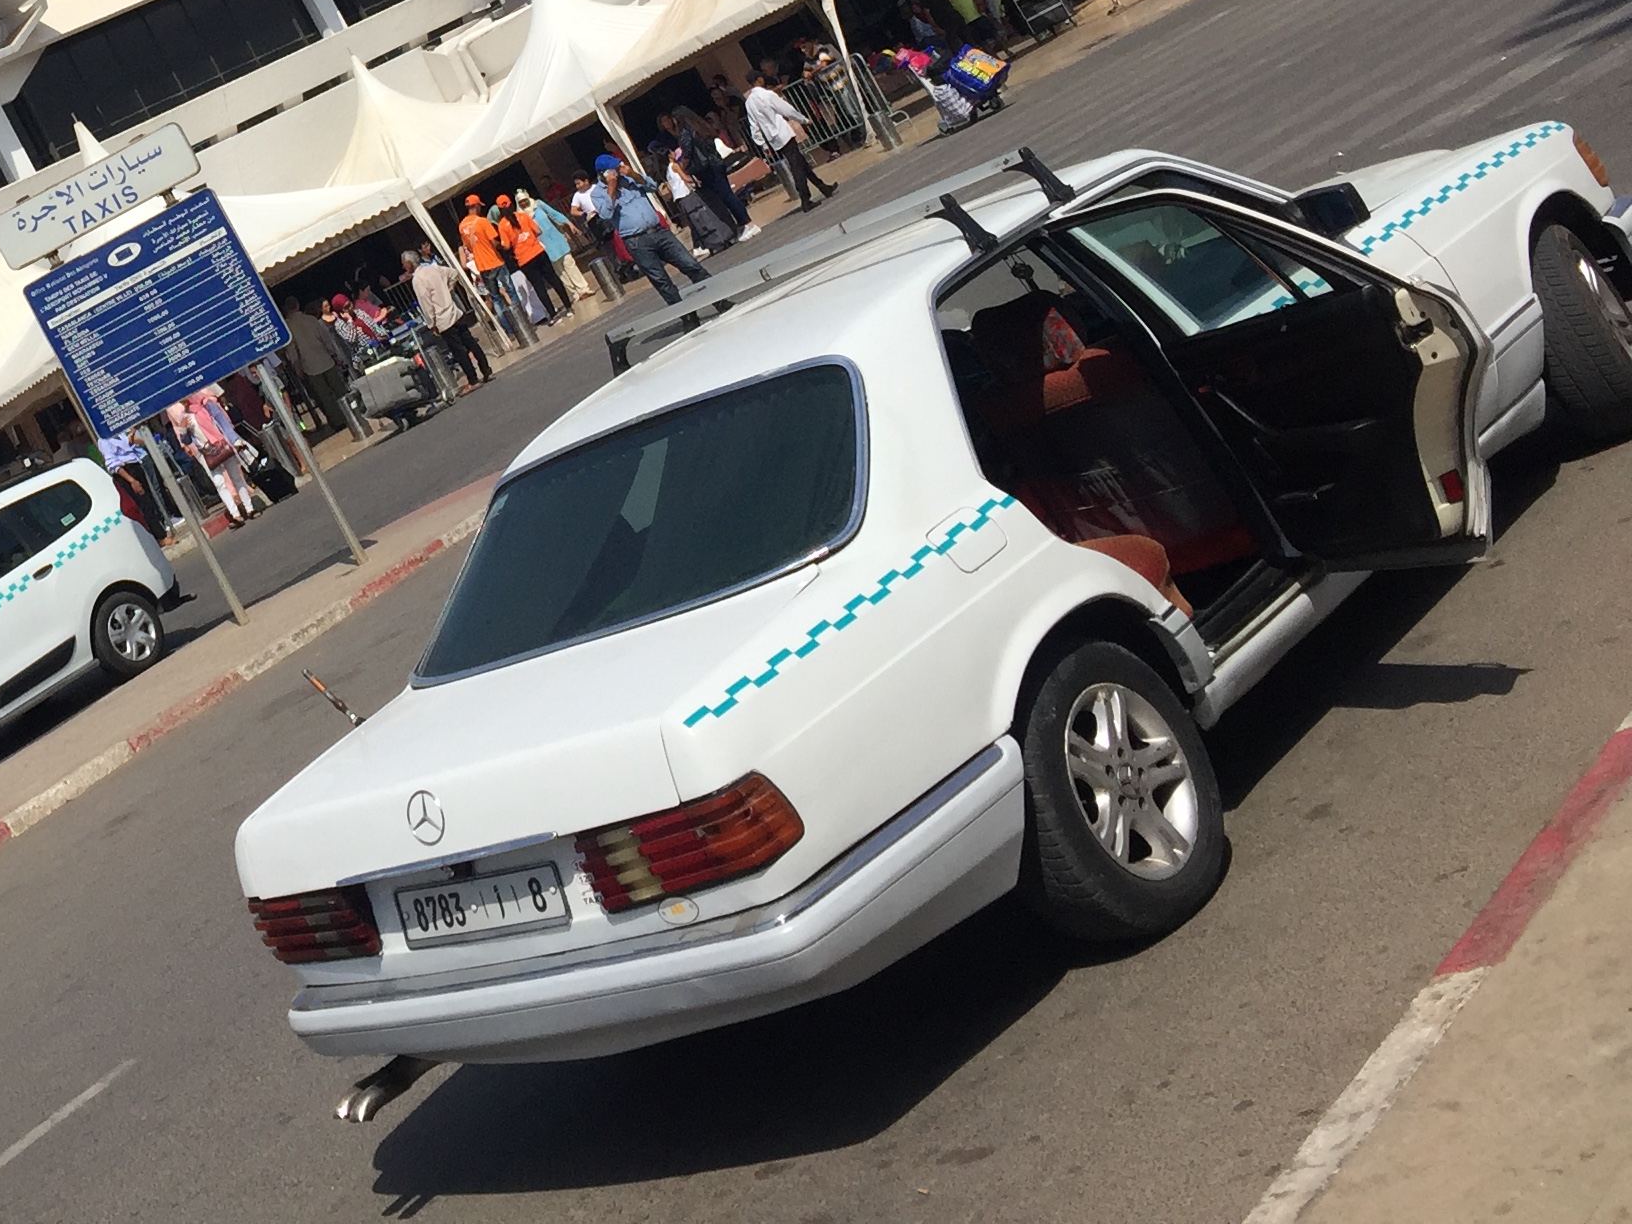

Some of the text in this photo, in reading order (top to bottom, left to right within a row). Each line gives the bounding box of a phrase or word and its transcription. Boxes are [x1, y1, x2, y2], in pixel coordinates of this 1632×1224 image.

[88, 145, 163, 191] سيارات
[62, 185, 139, 235] TAXIS
[413, 891, 467, 932] 8783
[527, 876, 548, 913] 8
